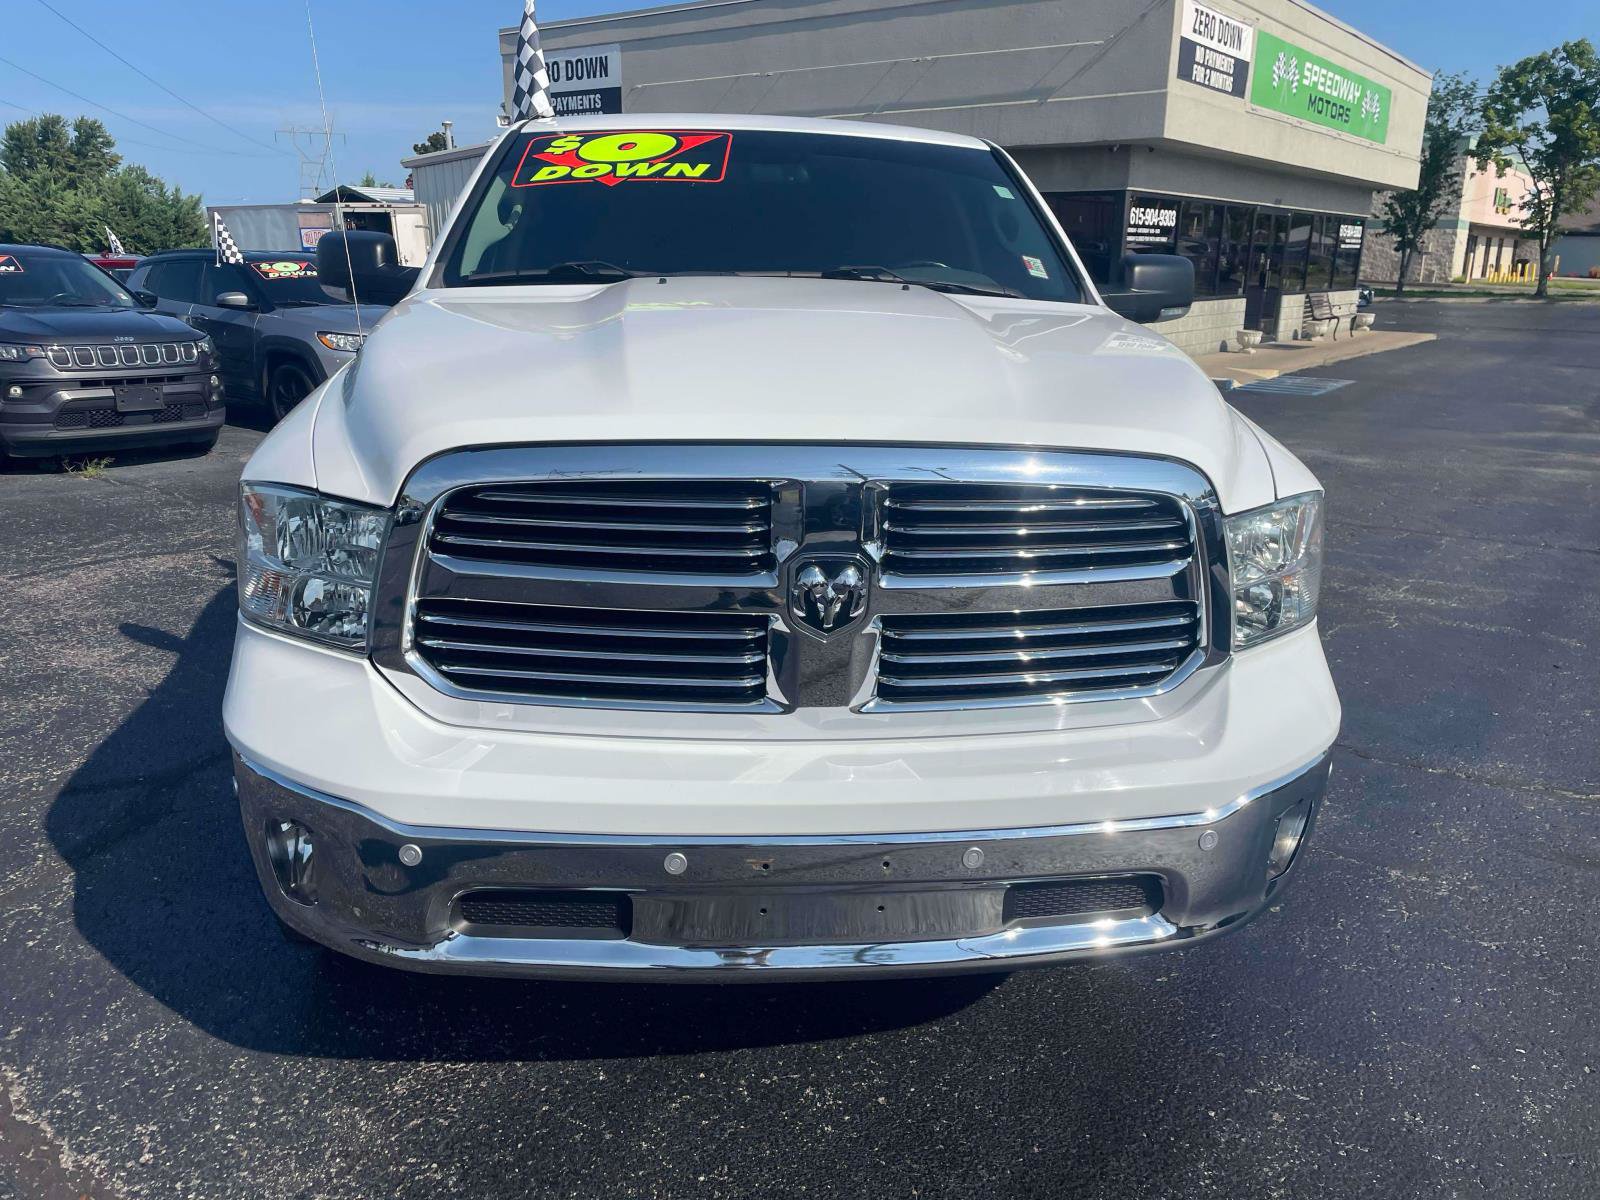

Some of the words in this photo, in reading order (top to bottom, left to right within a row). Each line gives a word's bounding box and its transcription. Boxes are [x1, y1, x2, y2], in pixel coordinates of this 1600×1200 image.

[1192, 7, 1217, 41] ZERO
[1217, 18, 1243, 51] DOWN
[565, 55, 609, 81] DOWN
[1194, 45, 1205, 64] NO
[1204, 48, 1235, 75] PAYMENTS
[1192, 63, 1205, 84] FOR
[1204, 68, 1211, 85] 2
[1209, 69, 1234, 92] MONTHS
[1302, 61, 1362, 105] SPEEDWAY
[550, 93, 602, 111] PAYMENTS
[1307, 92, 1351, 123] MOTORS
[529, 162, 712, 182] DOWN
[1130, 206, 1177, 227] 615-904-9303
[268, 270, 318, 278] DOWN
